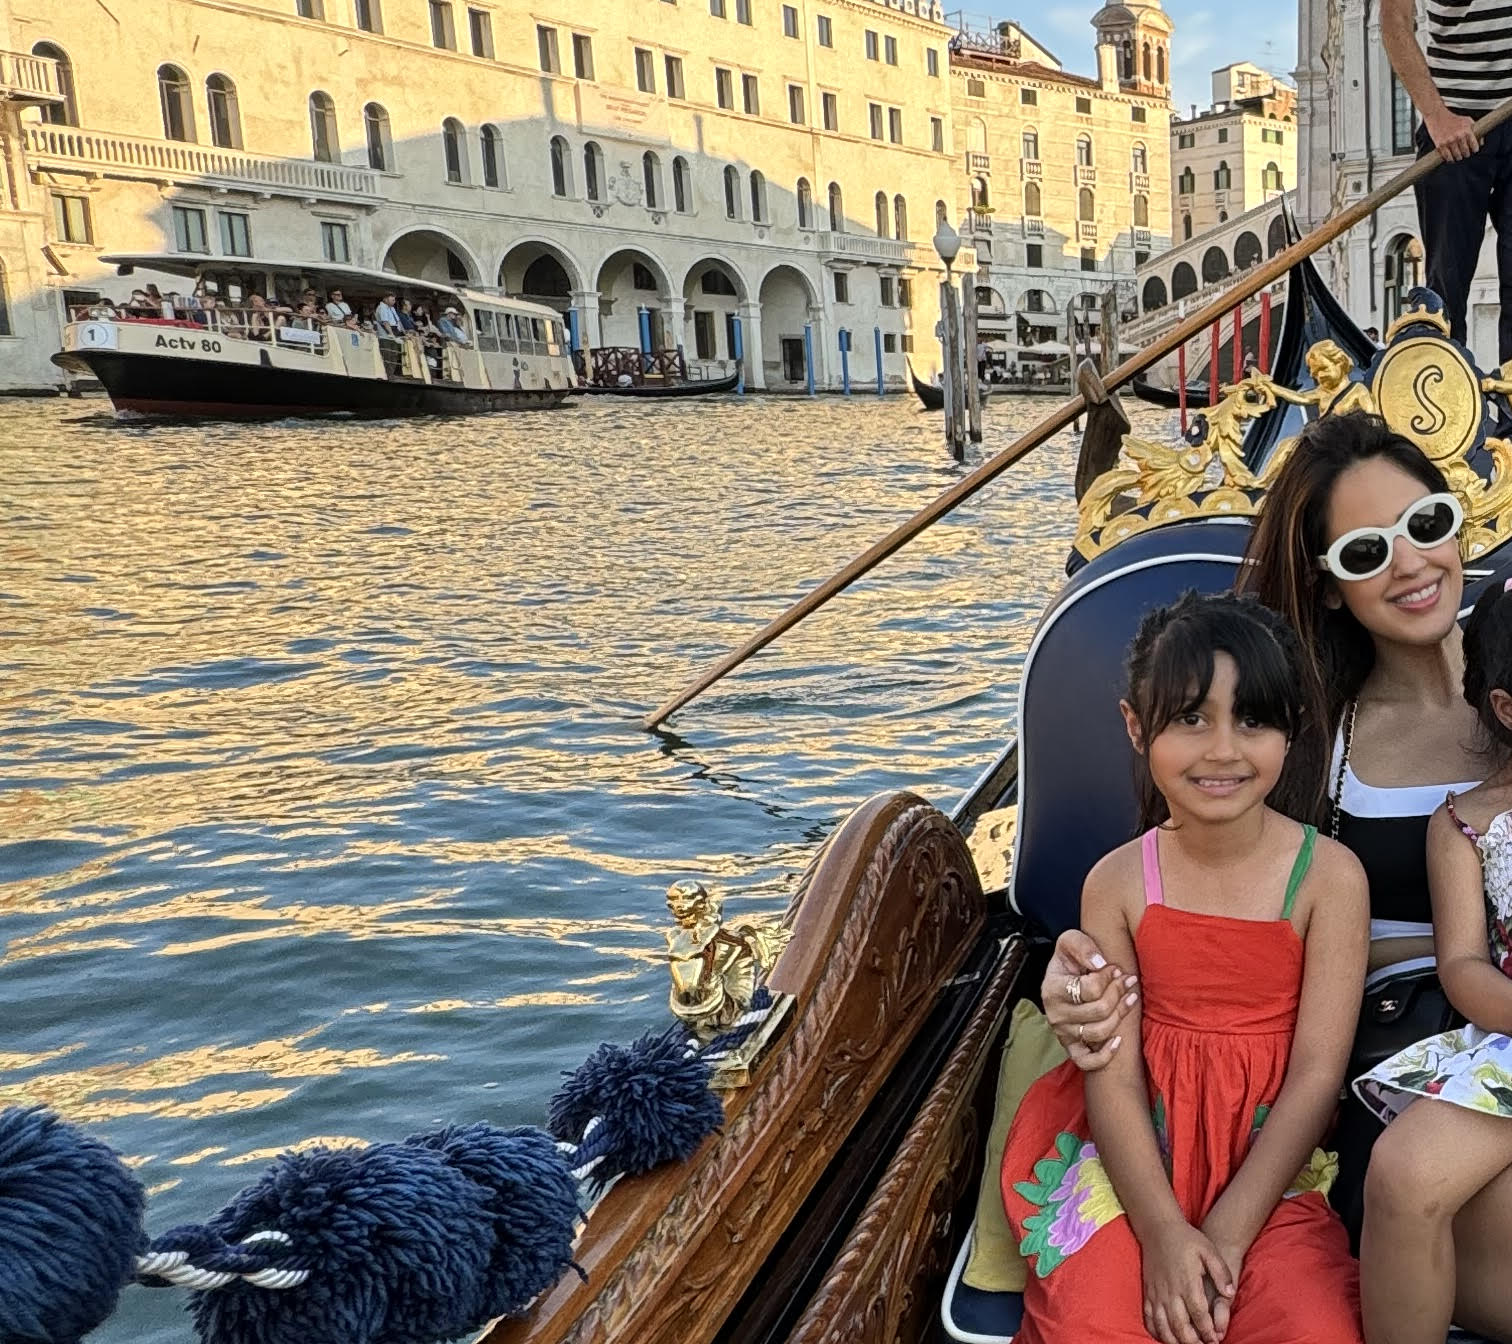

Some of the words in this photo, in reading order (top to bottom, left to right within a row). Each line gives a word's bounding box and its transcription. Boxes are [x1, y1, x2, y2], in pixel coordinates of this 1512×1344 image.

[87, 329, 95, 341] 1
[155, 334, 196, 351] Actv
[202, 339, 222, 353] 80
[1411, 364, 1447, 435] S
